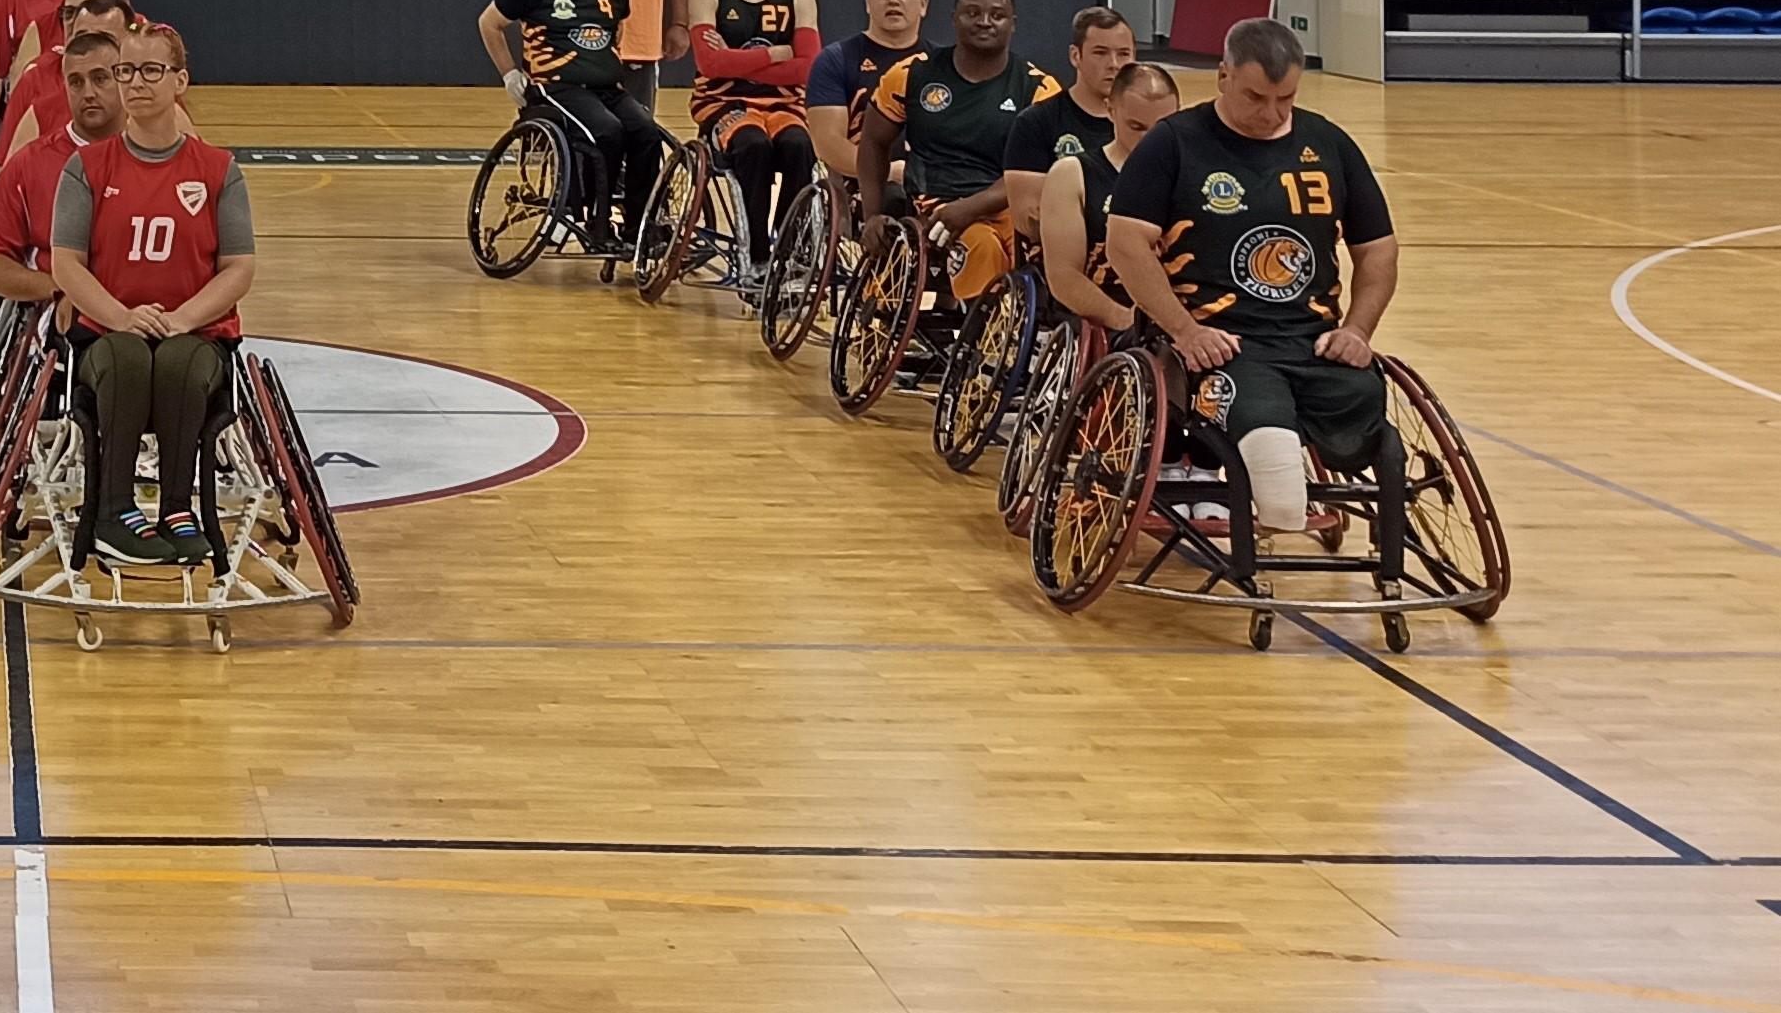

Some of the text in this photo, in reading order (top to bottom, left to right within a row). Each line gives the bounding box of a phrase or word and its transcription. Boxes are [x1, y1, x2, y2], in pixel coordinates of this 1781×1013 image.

[761, 5, 790, 32] 27
[1280, 171, 1333, 215] 13
[127, 216, 175, 261] 10
[1242, 271, 1311, 299] TIGRISEK
